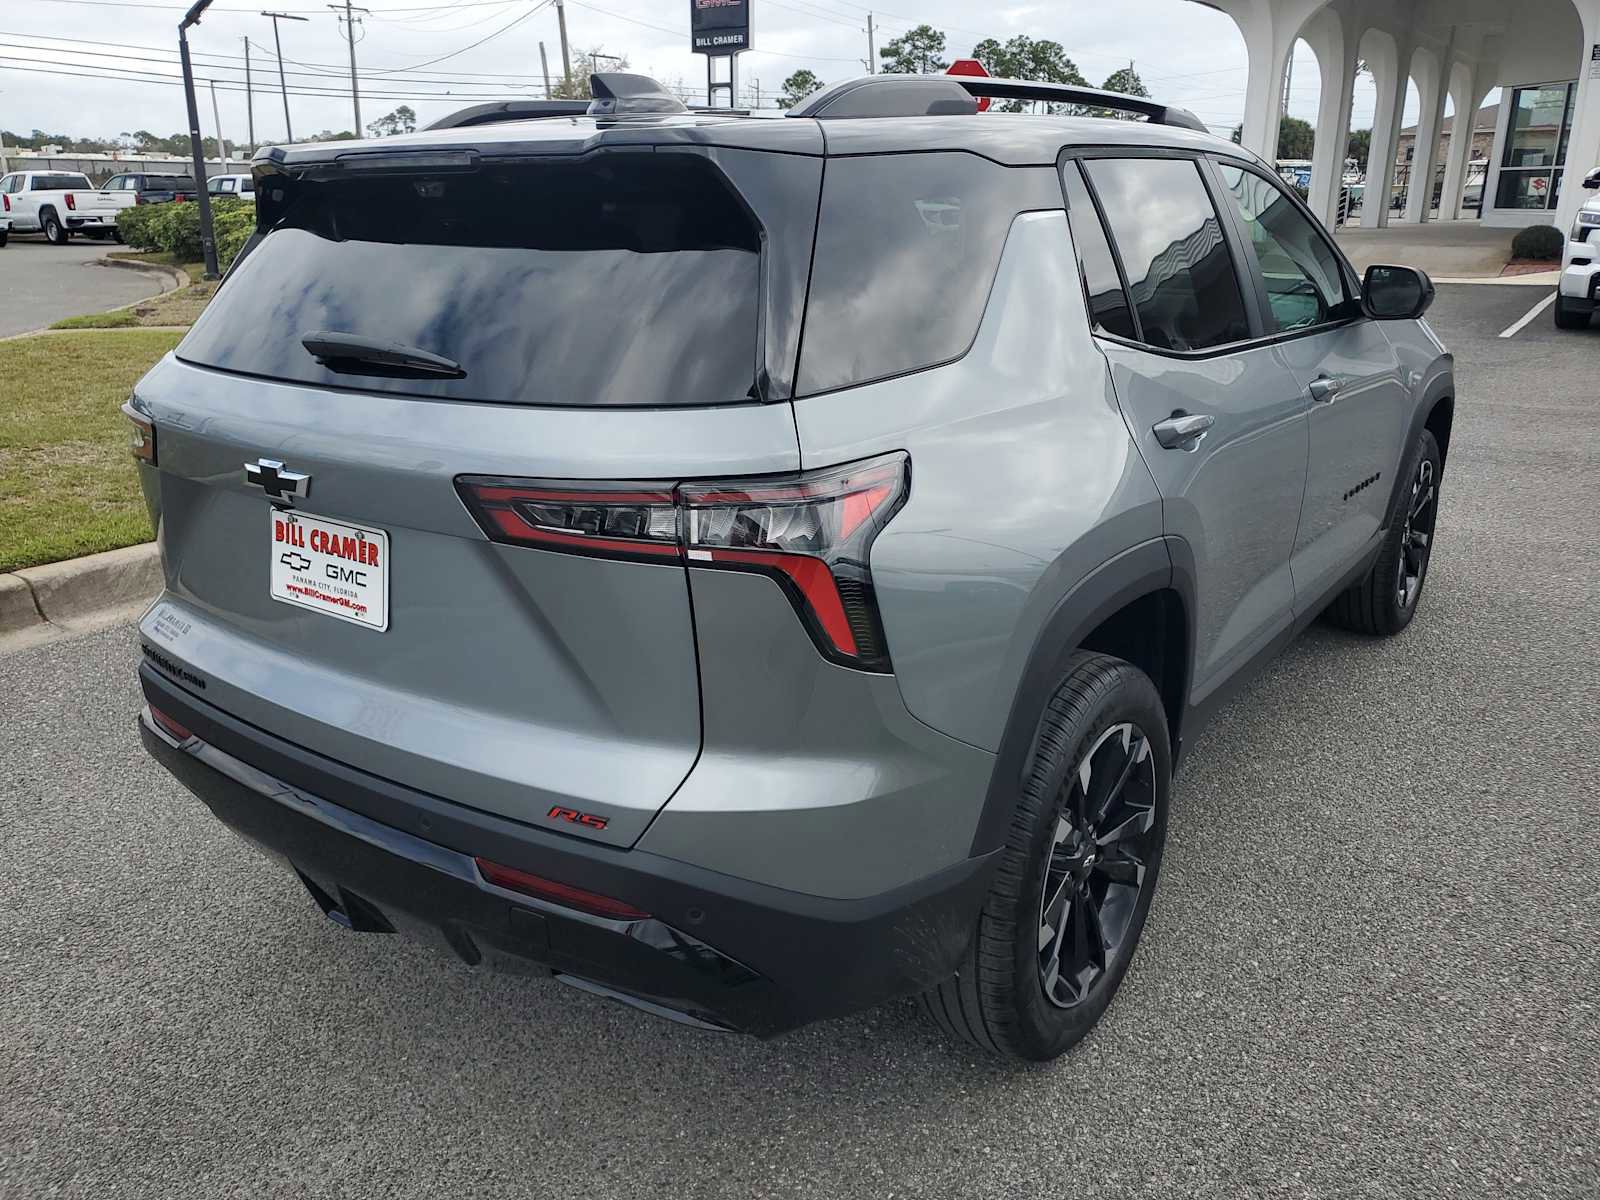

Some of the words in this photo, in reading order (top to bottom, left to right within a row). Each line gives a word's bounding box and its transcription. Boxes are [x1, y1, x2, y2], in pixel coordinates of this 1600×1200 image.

[696, 38, 711, 47] BILL
[713, 34, 744, 46] CRAMER
[275, 520, 305, 548] BILL
[310, 529, 379, 567] CRAMER
[292, 575, 316, 587] PANAMA
[334, 586, 358, 599] FLORIDA
[326, 563, 367, 587] GMC
[286, 584, 367, 613] www.BillCramerGM.com
[547, 806, 610, 830] RS
